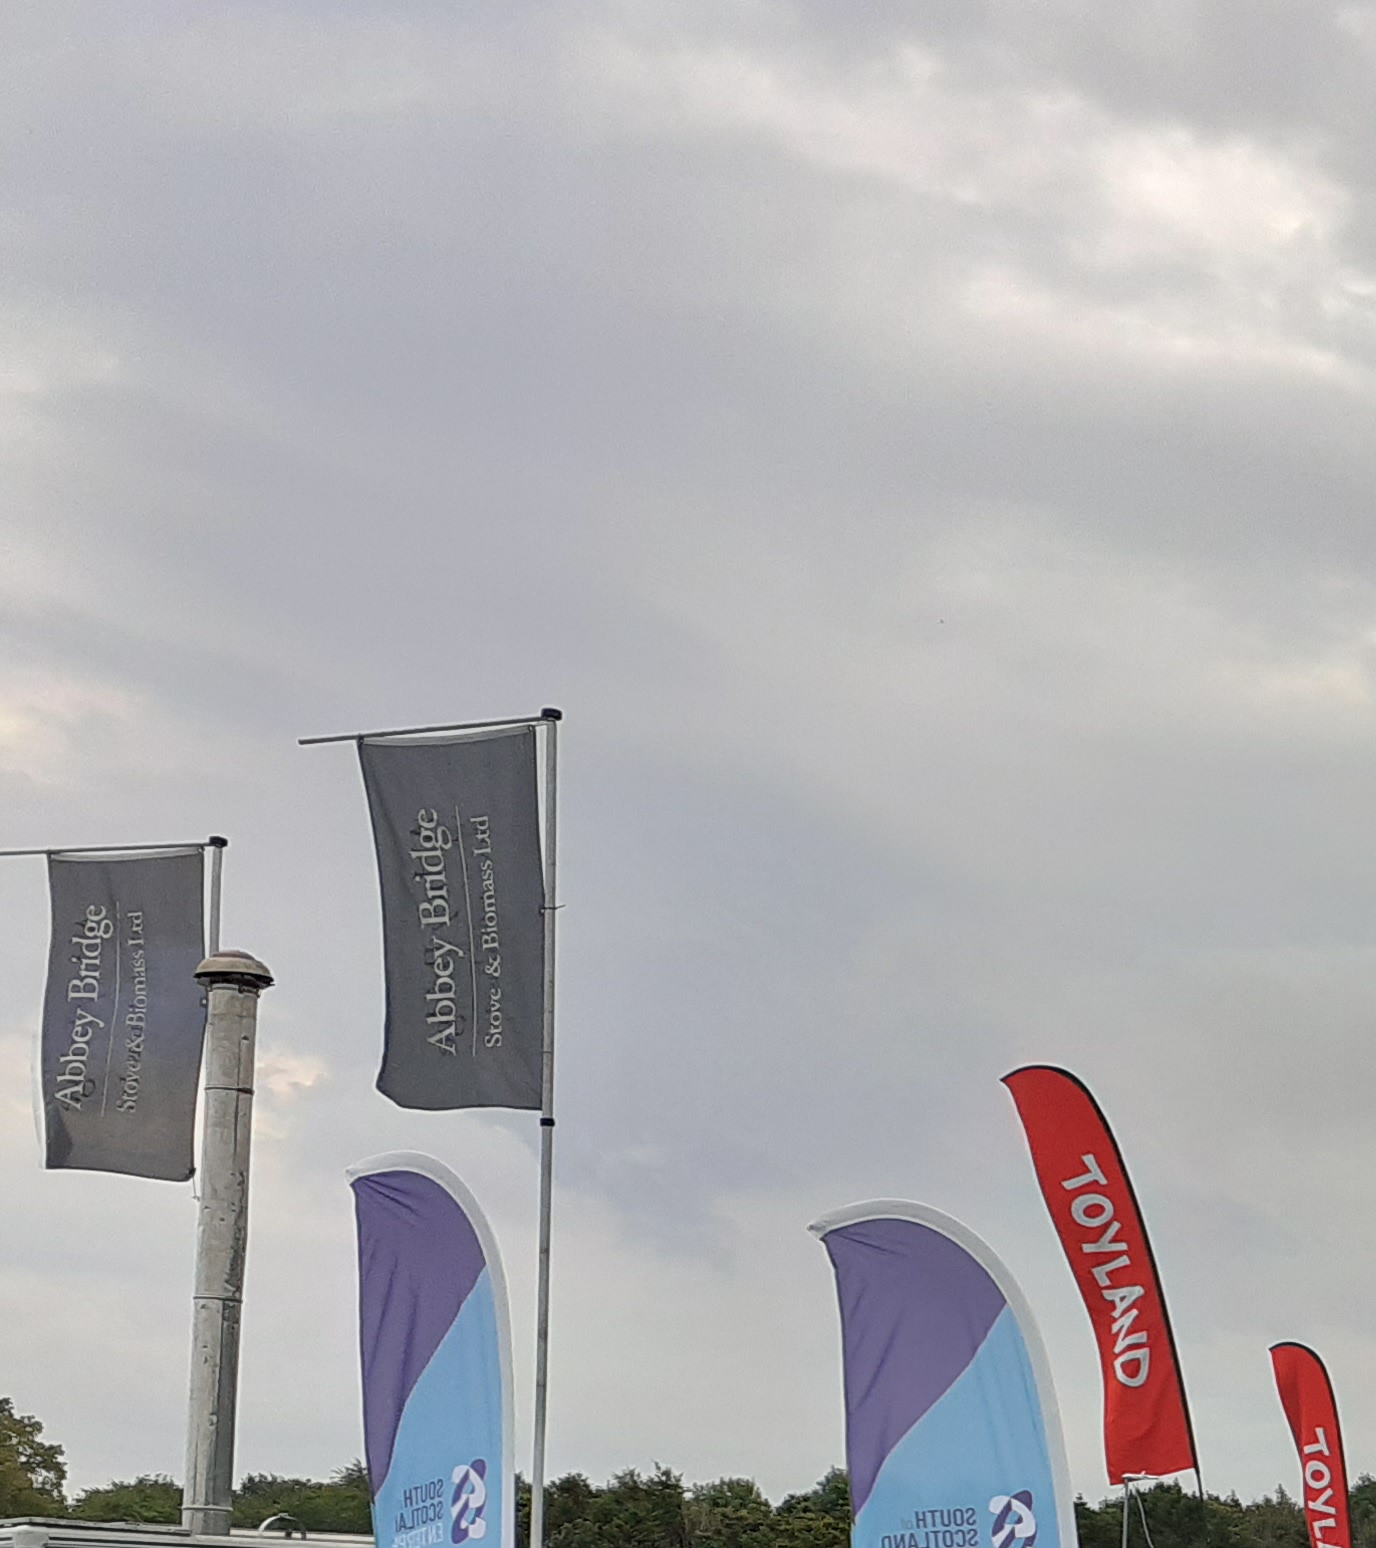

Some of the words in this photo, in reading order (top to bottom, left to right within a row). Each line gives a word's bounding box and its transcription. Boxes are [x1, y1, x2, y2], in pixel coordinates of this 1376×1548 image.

[410, 808, 452, 928] Bridge
[470, 815, 492, 856] Ltd
[480, 860, 500, 951] Biomass
[68, 905, 114, 1002] Bridge
[126, 950, 147, 1027] Biomass
[426, 936, 465, 1056] Abbey
[485, 955, 501, 977] &
[55, 1008, 104, 1110] Abbey
[484, 987, 503, 1048] Stove
[1061, 1153, 1150, 1388] TOYLAND
